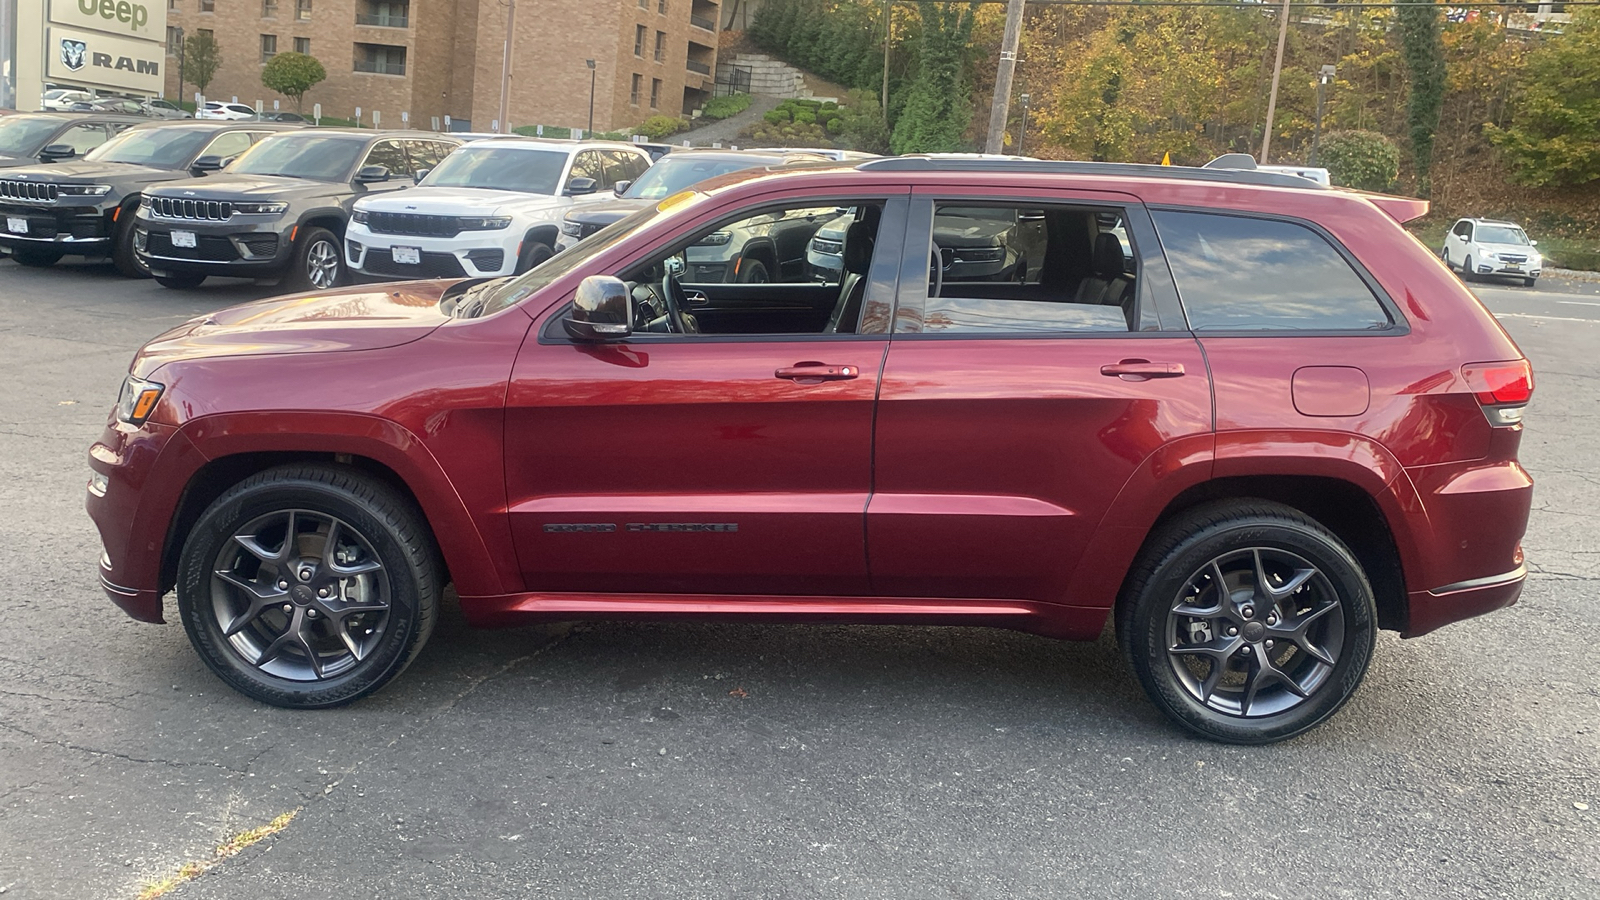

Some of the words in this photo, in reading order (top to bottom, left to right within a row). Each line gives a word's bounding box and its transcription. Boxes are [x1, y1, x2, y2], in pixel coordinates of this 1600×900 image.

[92, 52, 159, 76] RAM
[543, 523, 617, 532] GRAND
[625, 522, 739, 532] CHEROKEE
